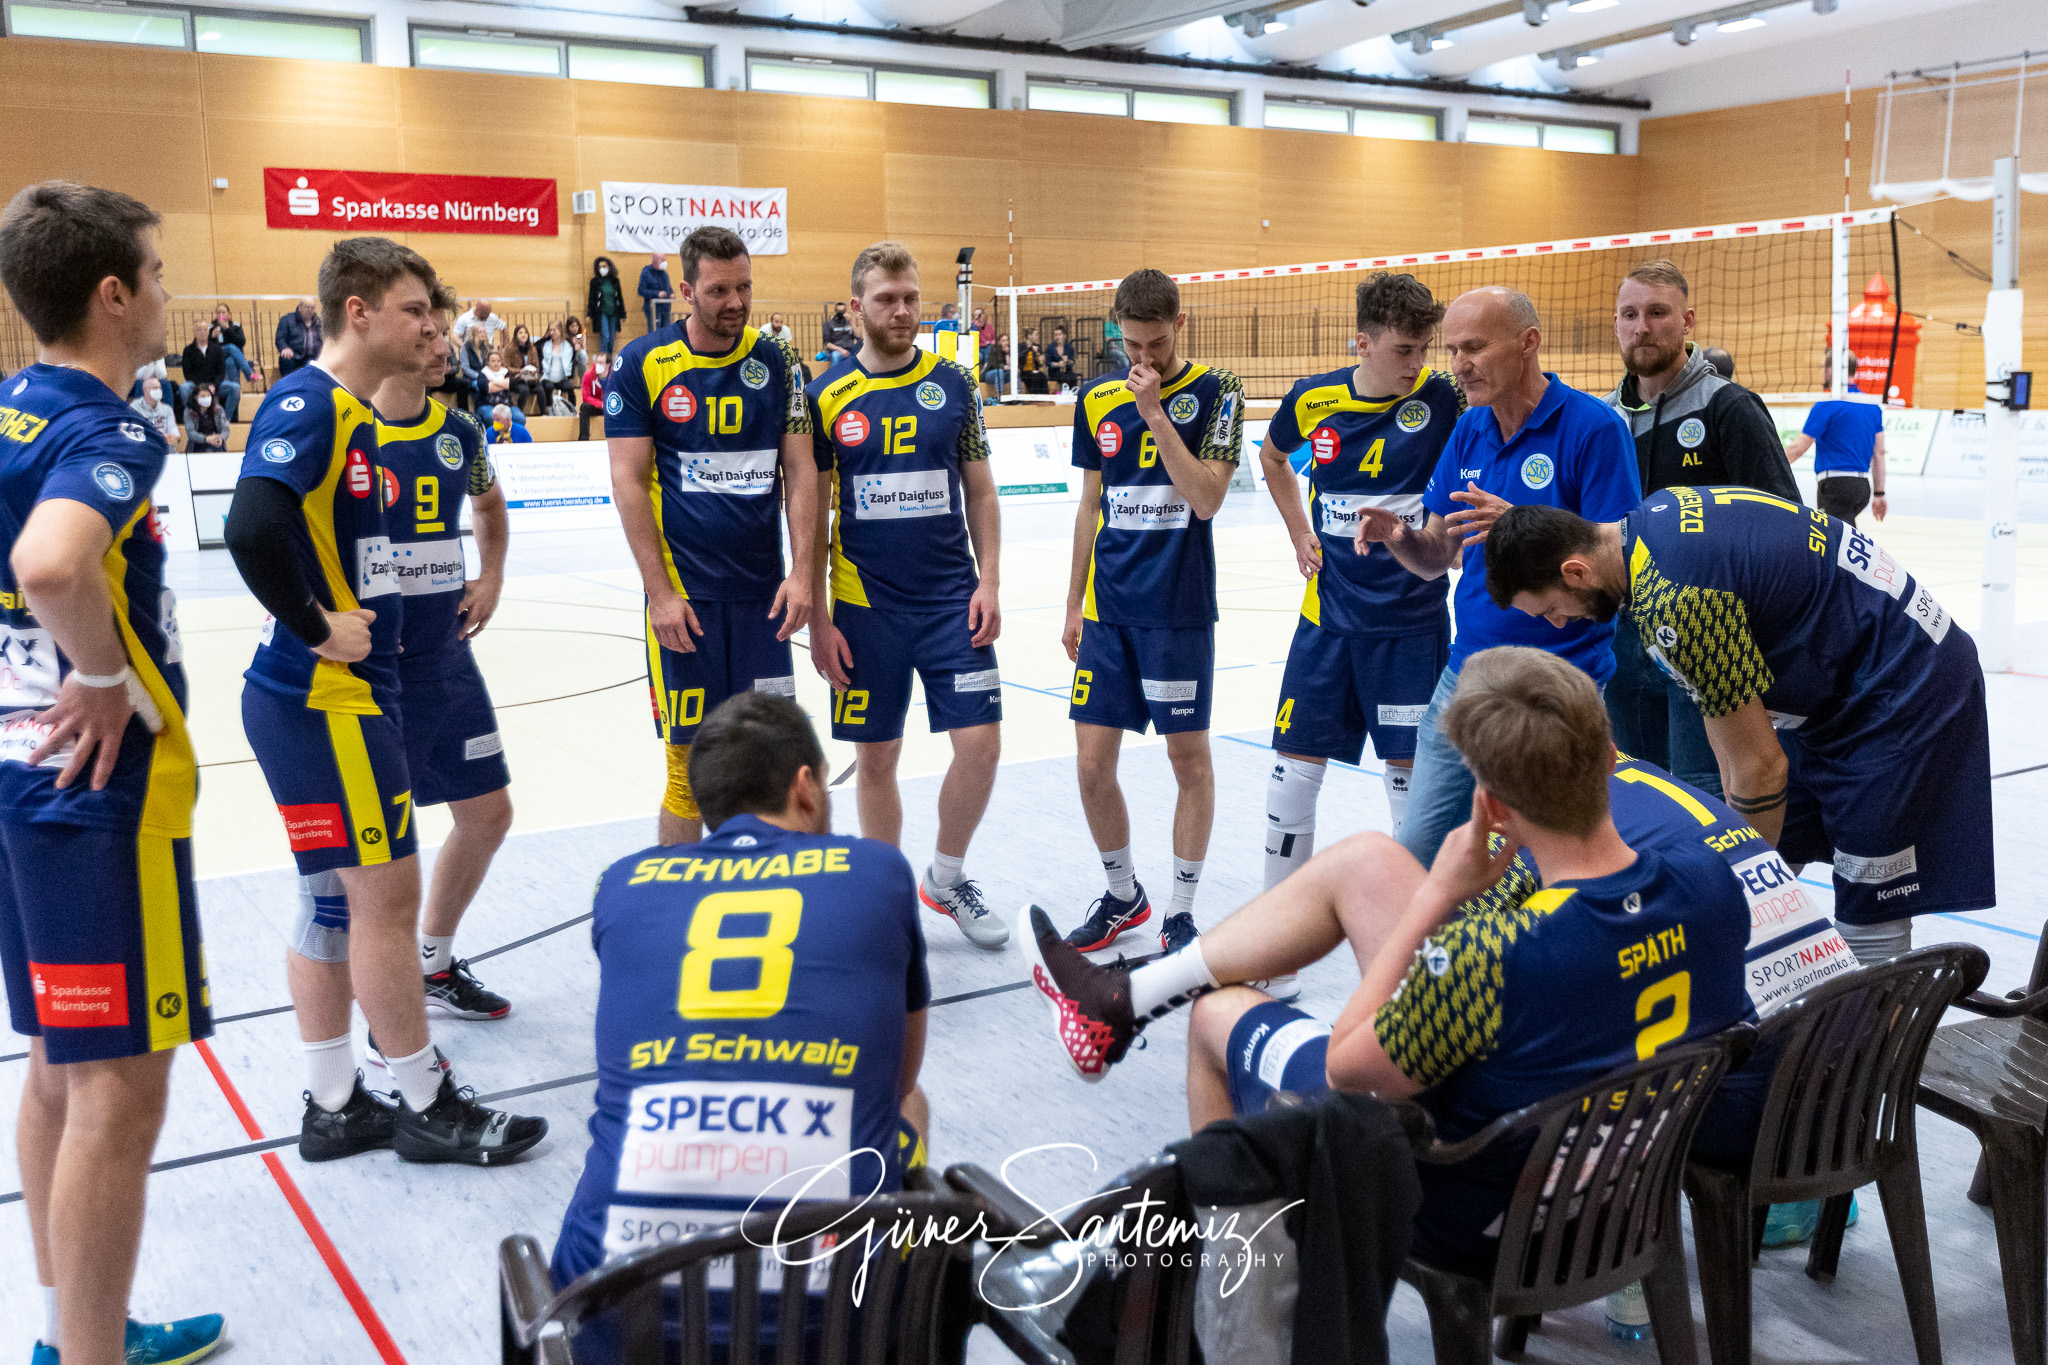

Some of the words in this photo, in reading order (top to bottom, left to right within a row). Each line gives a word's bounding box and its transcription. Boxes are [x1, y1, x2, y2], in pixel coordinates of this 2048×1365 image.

[332, 197, 439, 221] Sparkasse
[445, 200, 540, 227] Nürnberg
[609, 194, 781, 219] SPORTNANKA
[615, 222, 783, 241] www.spoka.de
[655, 352, 682, 364] Kempa
[830, 379, 858, 398] Kempa
[1094, 386, 1121, 399] Kempa
[1305, 398, 1339, 410] Kempa
[705, 395, 743, 434] 10
[1218, 419, 1228, 441] puls
[881, 415, 917, 455] 12
[1139, 430, 1158, 468] 6
[1358, 438, 1385, 478] 4
[1682, 452, 1703, 467] AL
[698, 471, 724, 483] Zapf
[726, 468, 775, 482] Daigfuss
[416, 476, 439, 520] 9
[869, 492, 896, 505] Zapf
[898, 489, 944, 503] Daigfuss
[1117, 504, 1140, 516] Zapf
[1142, 503, 1185, 516] Daigfuss
[1332, 510, 1356, 523] Zapf
[1809, 525, 1827, 557] SV
[1846, 527, 1874, 571] SPE
[398, 564, 428, 578] Zapf
[431, 560, 463, 576] Daigfus
[1072, 669, 1093, 706] 6
[669, 687, 705, 727] 10
[833, 689, 870, 724] 12
[1171, 707, 1195, 716] Kempa
[1275, 698, 1295, 734] 4
[1381, 708, 1425, 720] HÜTTIN
[1613, 767, 1718, 827] 1
[287, 818, 332, 830] Sparkasse
[393, 789, 411, 840] 7
[290, 829, 333, 841] Nürnberg
[1703, 825, 1763, 853] Schw
[628, 847, 852, 886] SCHWABE
[1739, 858, 1794, 896] ECK
[1876, 882, 1920, 900] Kempa
[1750, 888, 1809, 929] umpen
[677, 887, 804, 1020] 8
[1617, 923, 1687, 979] SPÄTH
[50, 984, 112, 998] Sparkasse
[52, 1000, 110, 1013] Nürnberg
[1635, 970, 1691, 1061] 2
[629, 1036, 677, 1071] SV
[684, 1032, 860, 1076] Schwaig
[1243, 1022, 1271, 1073] Kempa
[641, 1094, 790, 1135] SPECK
[634, 1141, 788, 1183] pumpen
